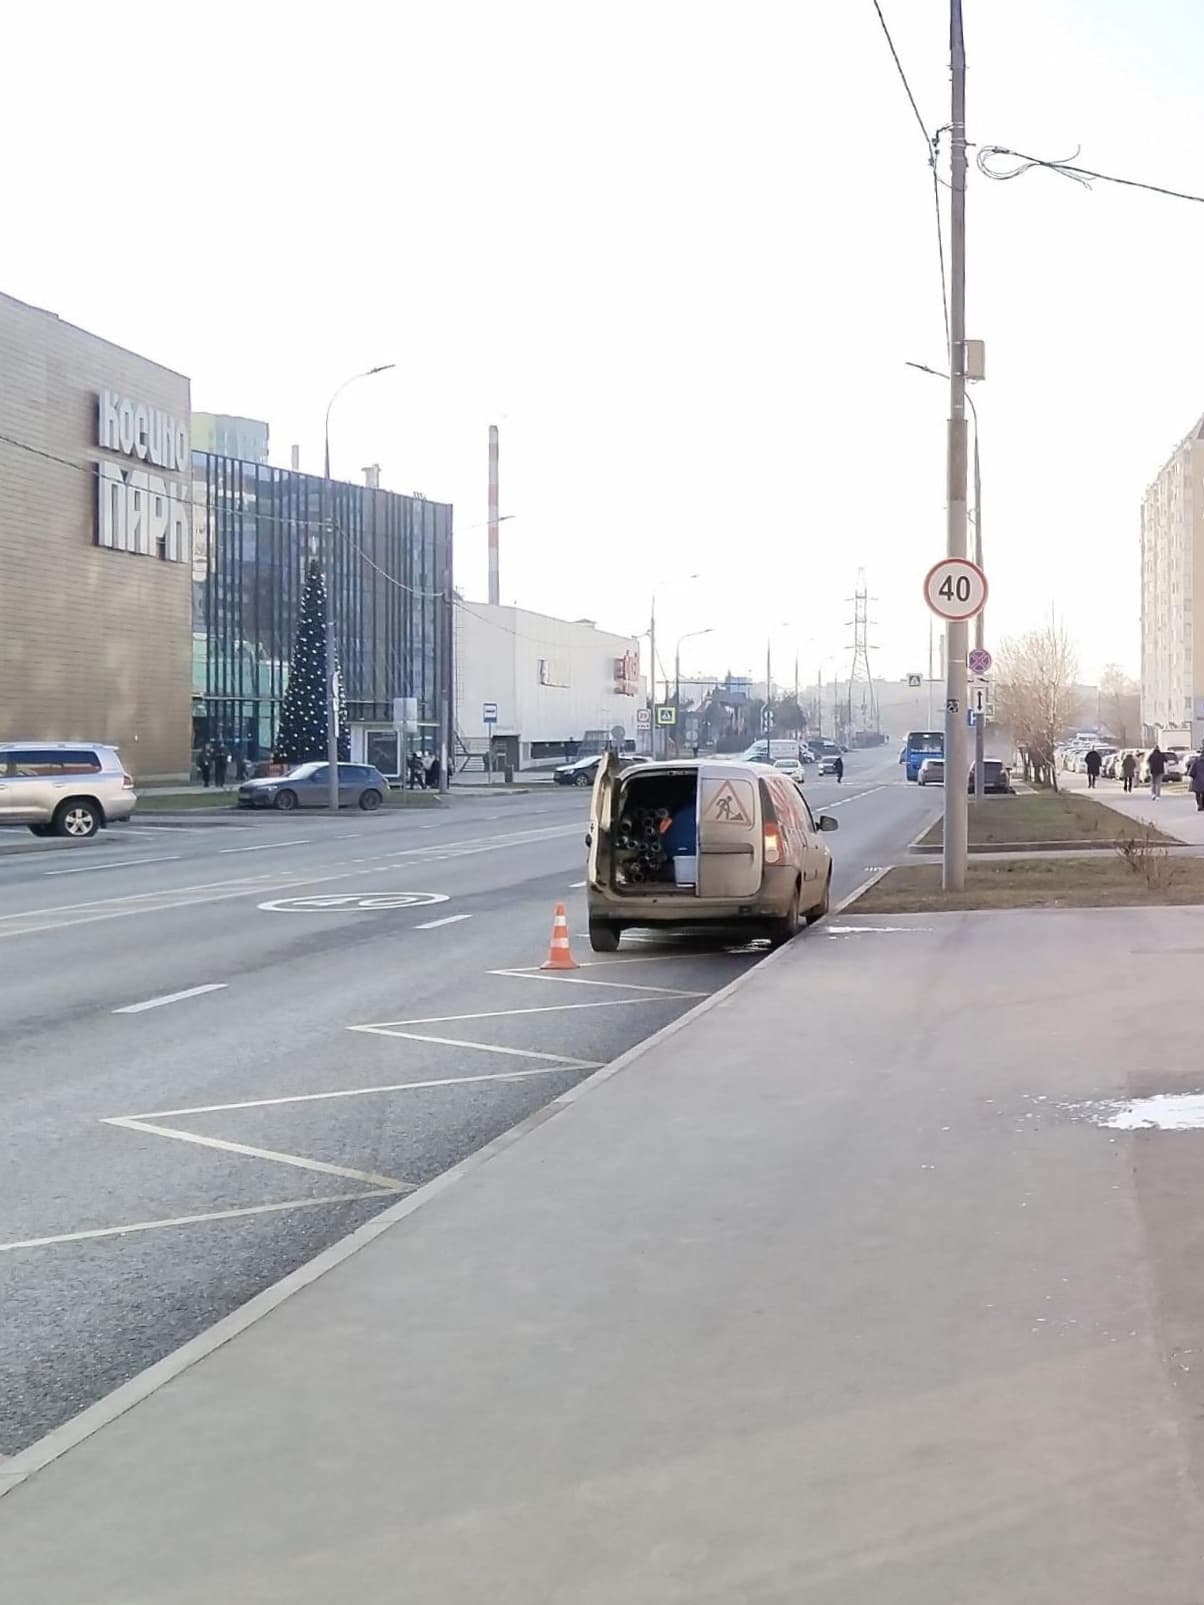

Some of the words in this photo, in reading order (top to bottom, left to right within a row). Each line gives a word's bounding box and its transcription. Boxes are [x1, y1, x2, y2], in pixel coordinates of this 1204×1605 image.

[98, 388, 188, 472] КОСИНО
[98, 460, 188, 563] ПАРК
[938, 575, 971, 602] 40
